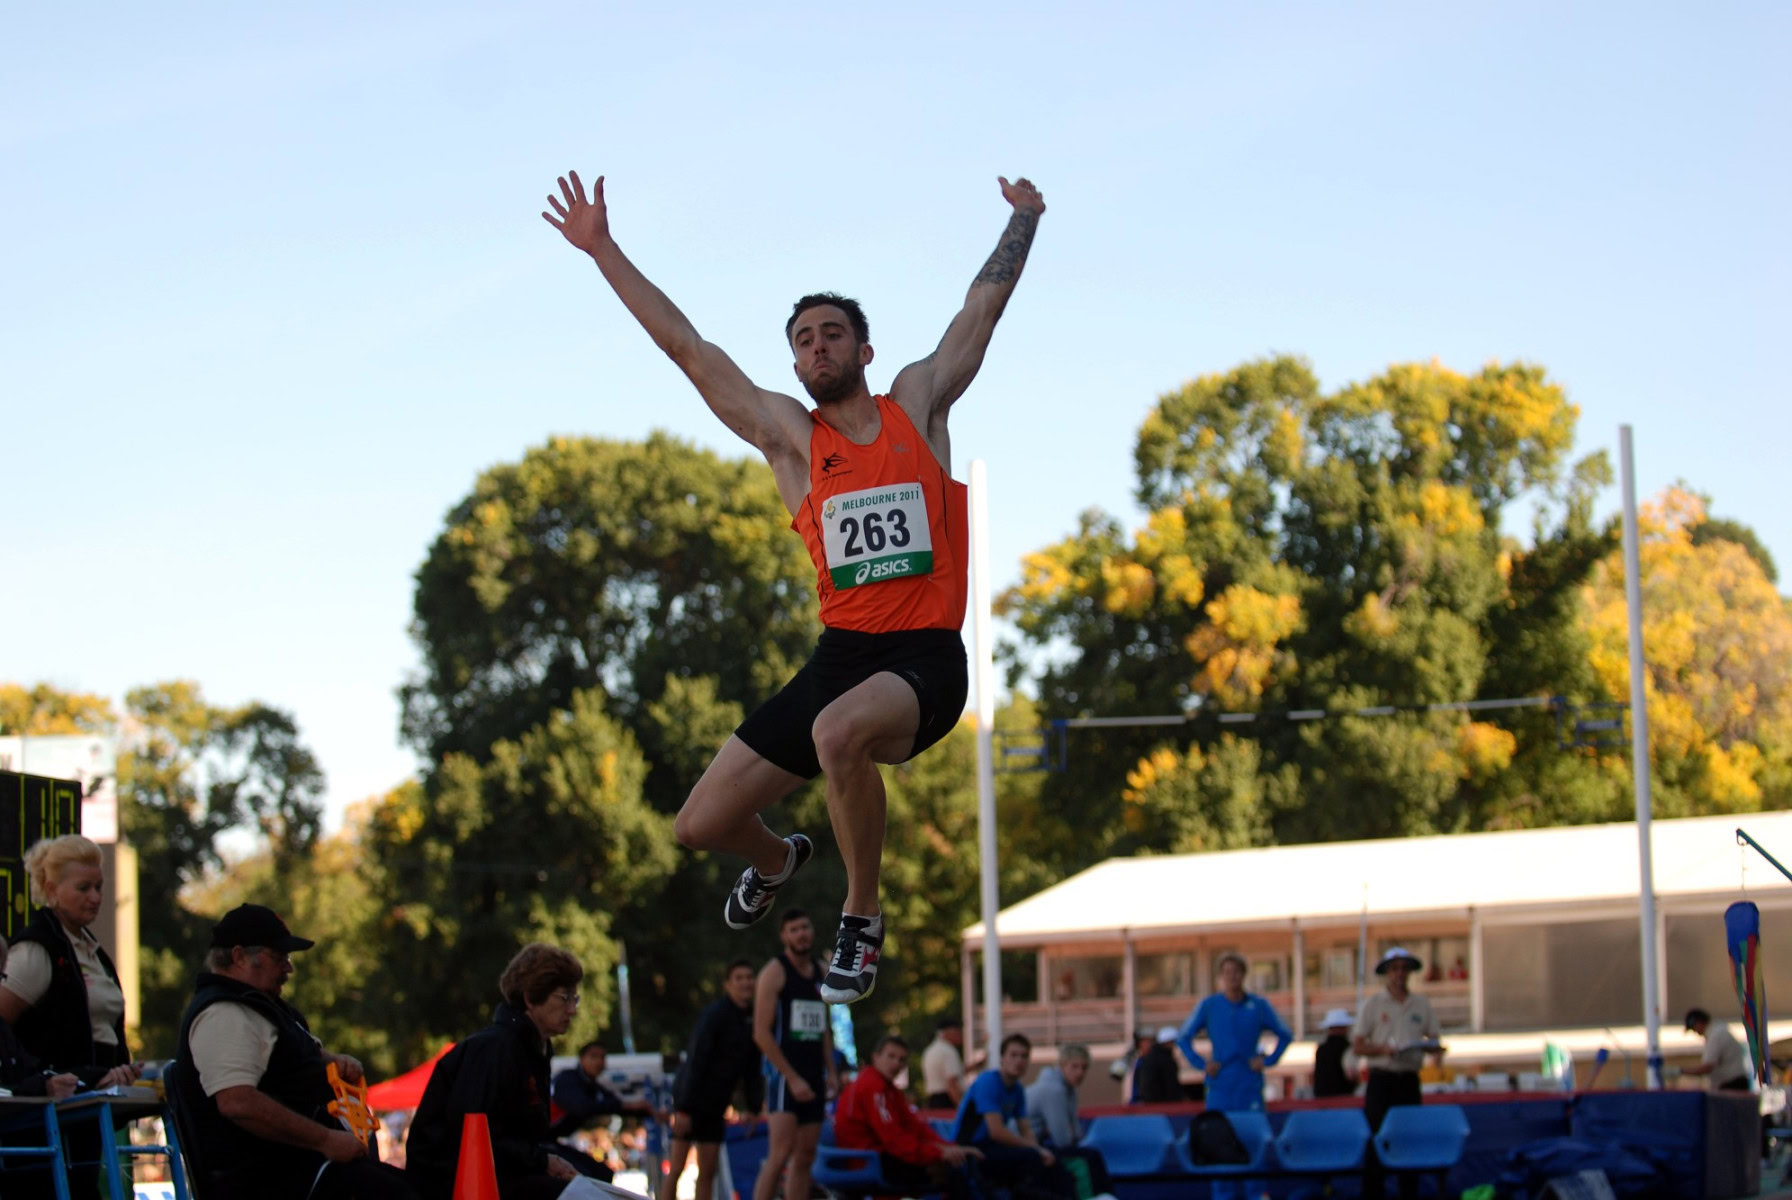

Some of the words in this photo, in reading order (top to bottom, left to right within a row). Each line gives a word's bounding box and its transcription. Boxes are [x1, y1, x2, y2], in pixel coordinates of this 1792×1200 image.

[842, 493, 897, 511] MELBOURNE
[899, 490, 919, 501] 2011
[840, 508, 911, 558] 263
